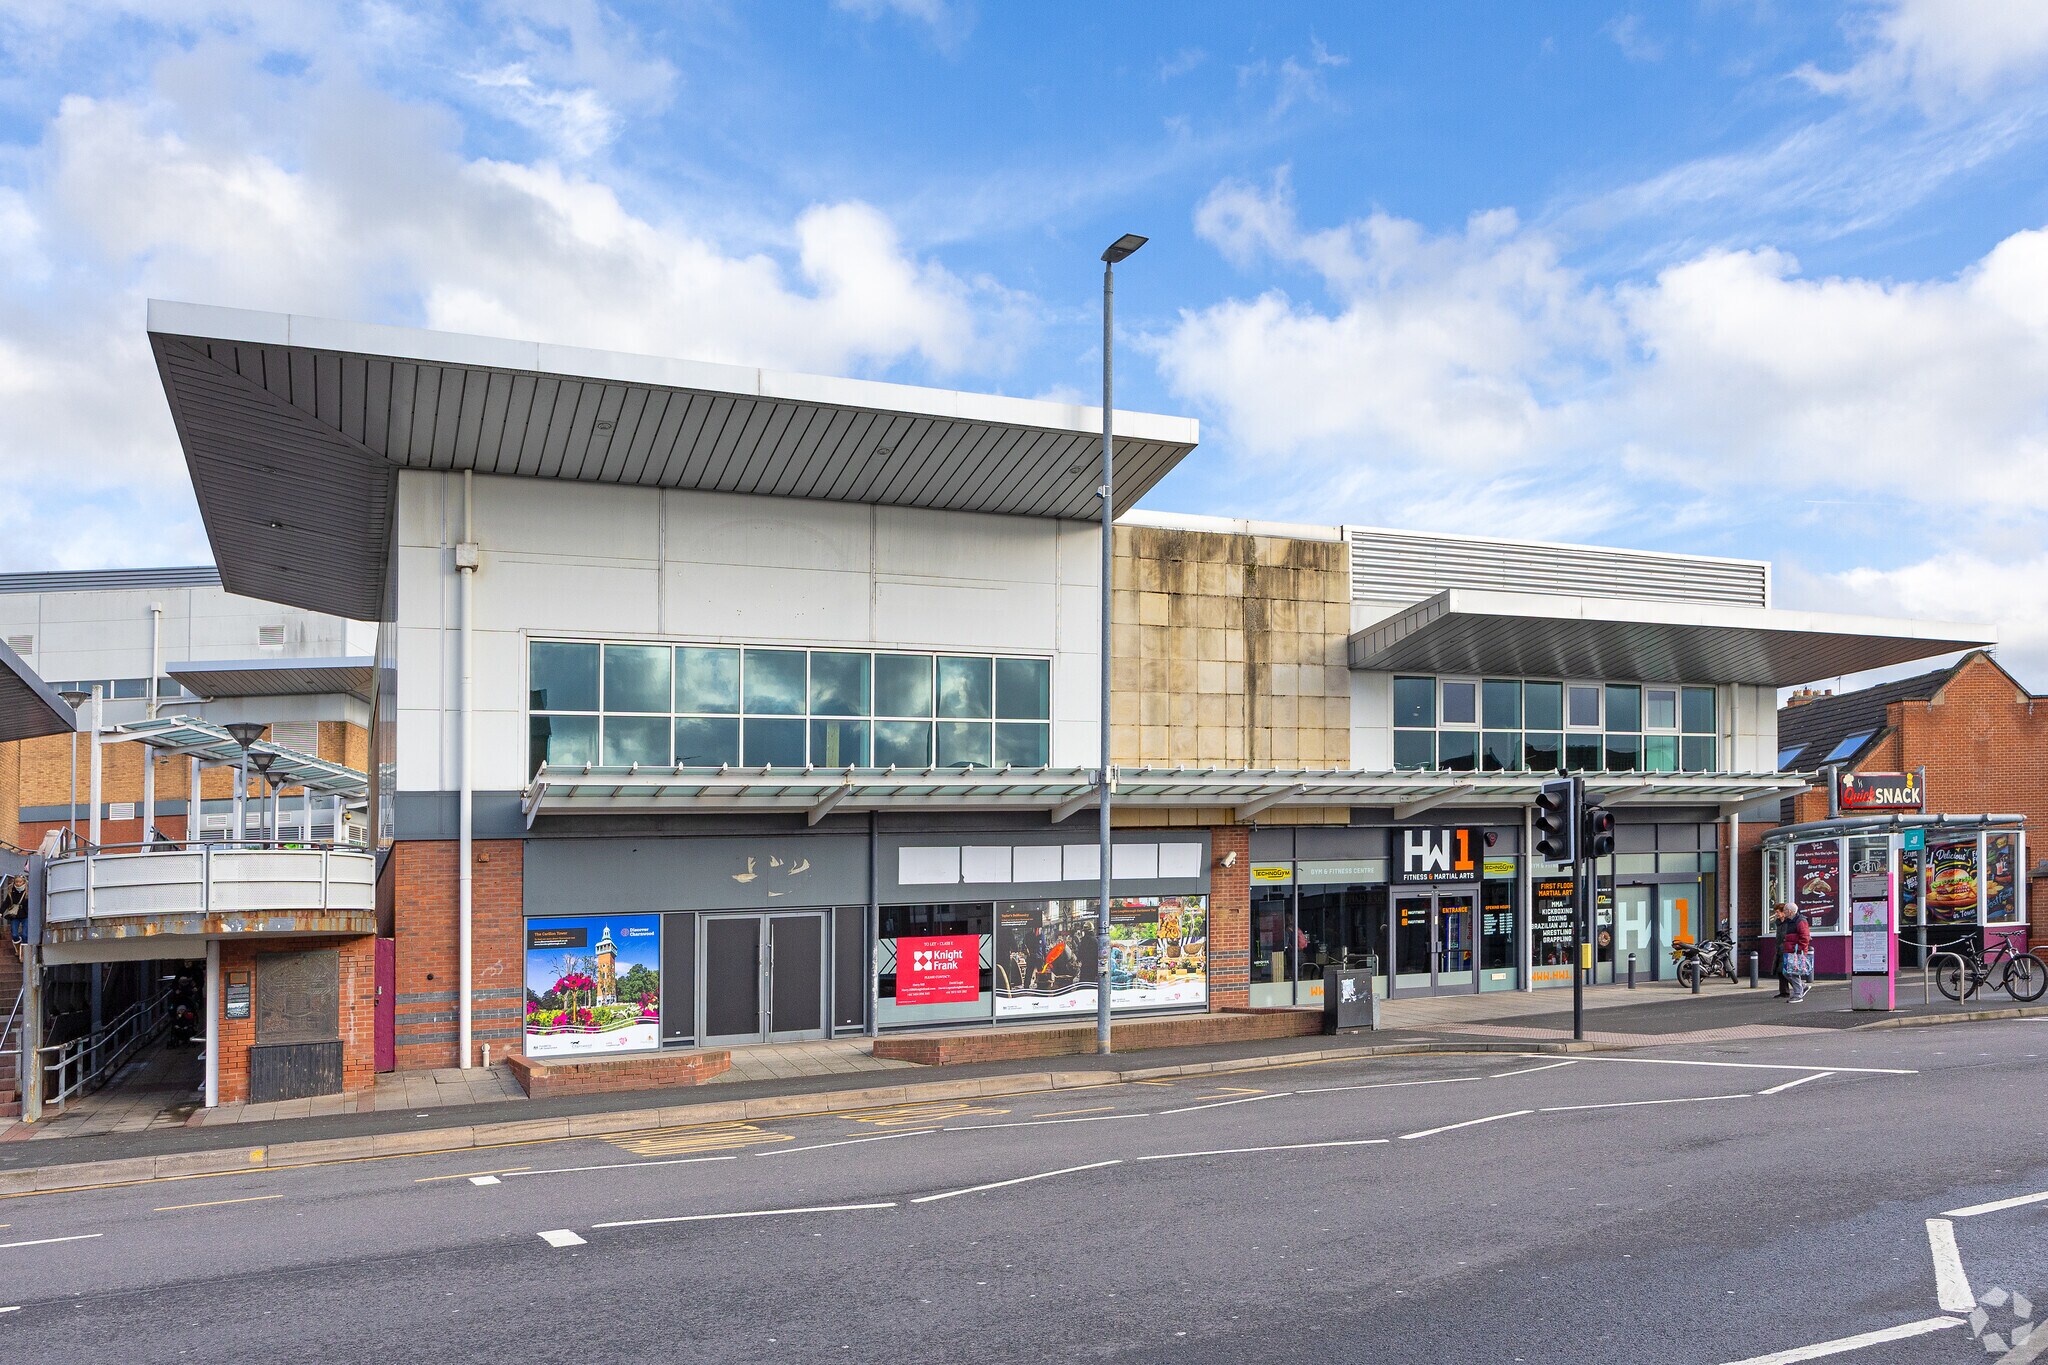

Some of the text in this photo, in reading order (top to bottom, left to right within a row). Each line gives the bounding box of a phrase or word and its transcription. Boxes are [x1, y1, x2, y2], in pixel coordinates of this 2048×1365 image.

[1844, 786, 1921, 806] Quick SNACK
[1404, 829, 1474, 872] HW1
[1936, 849, 1966, 860] Delicious
[1853, 862, 1879, 872] OPEN
[1434, 872, 1458, 880] MARTIAL
[1803, 871, 1831, 880] TACOS
[1960, 909, 1976, 918] Town
[1618, 898, 1694, 950] HW1
[934, 950, 962, 961] Knight
[934, 961, 958, 970] Frank
